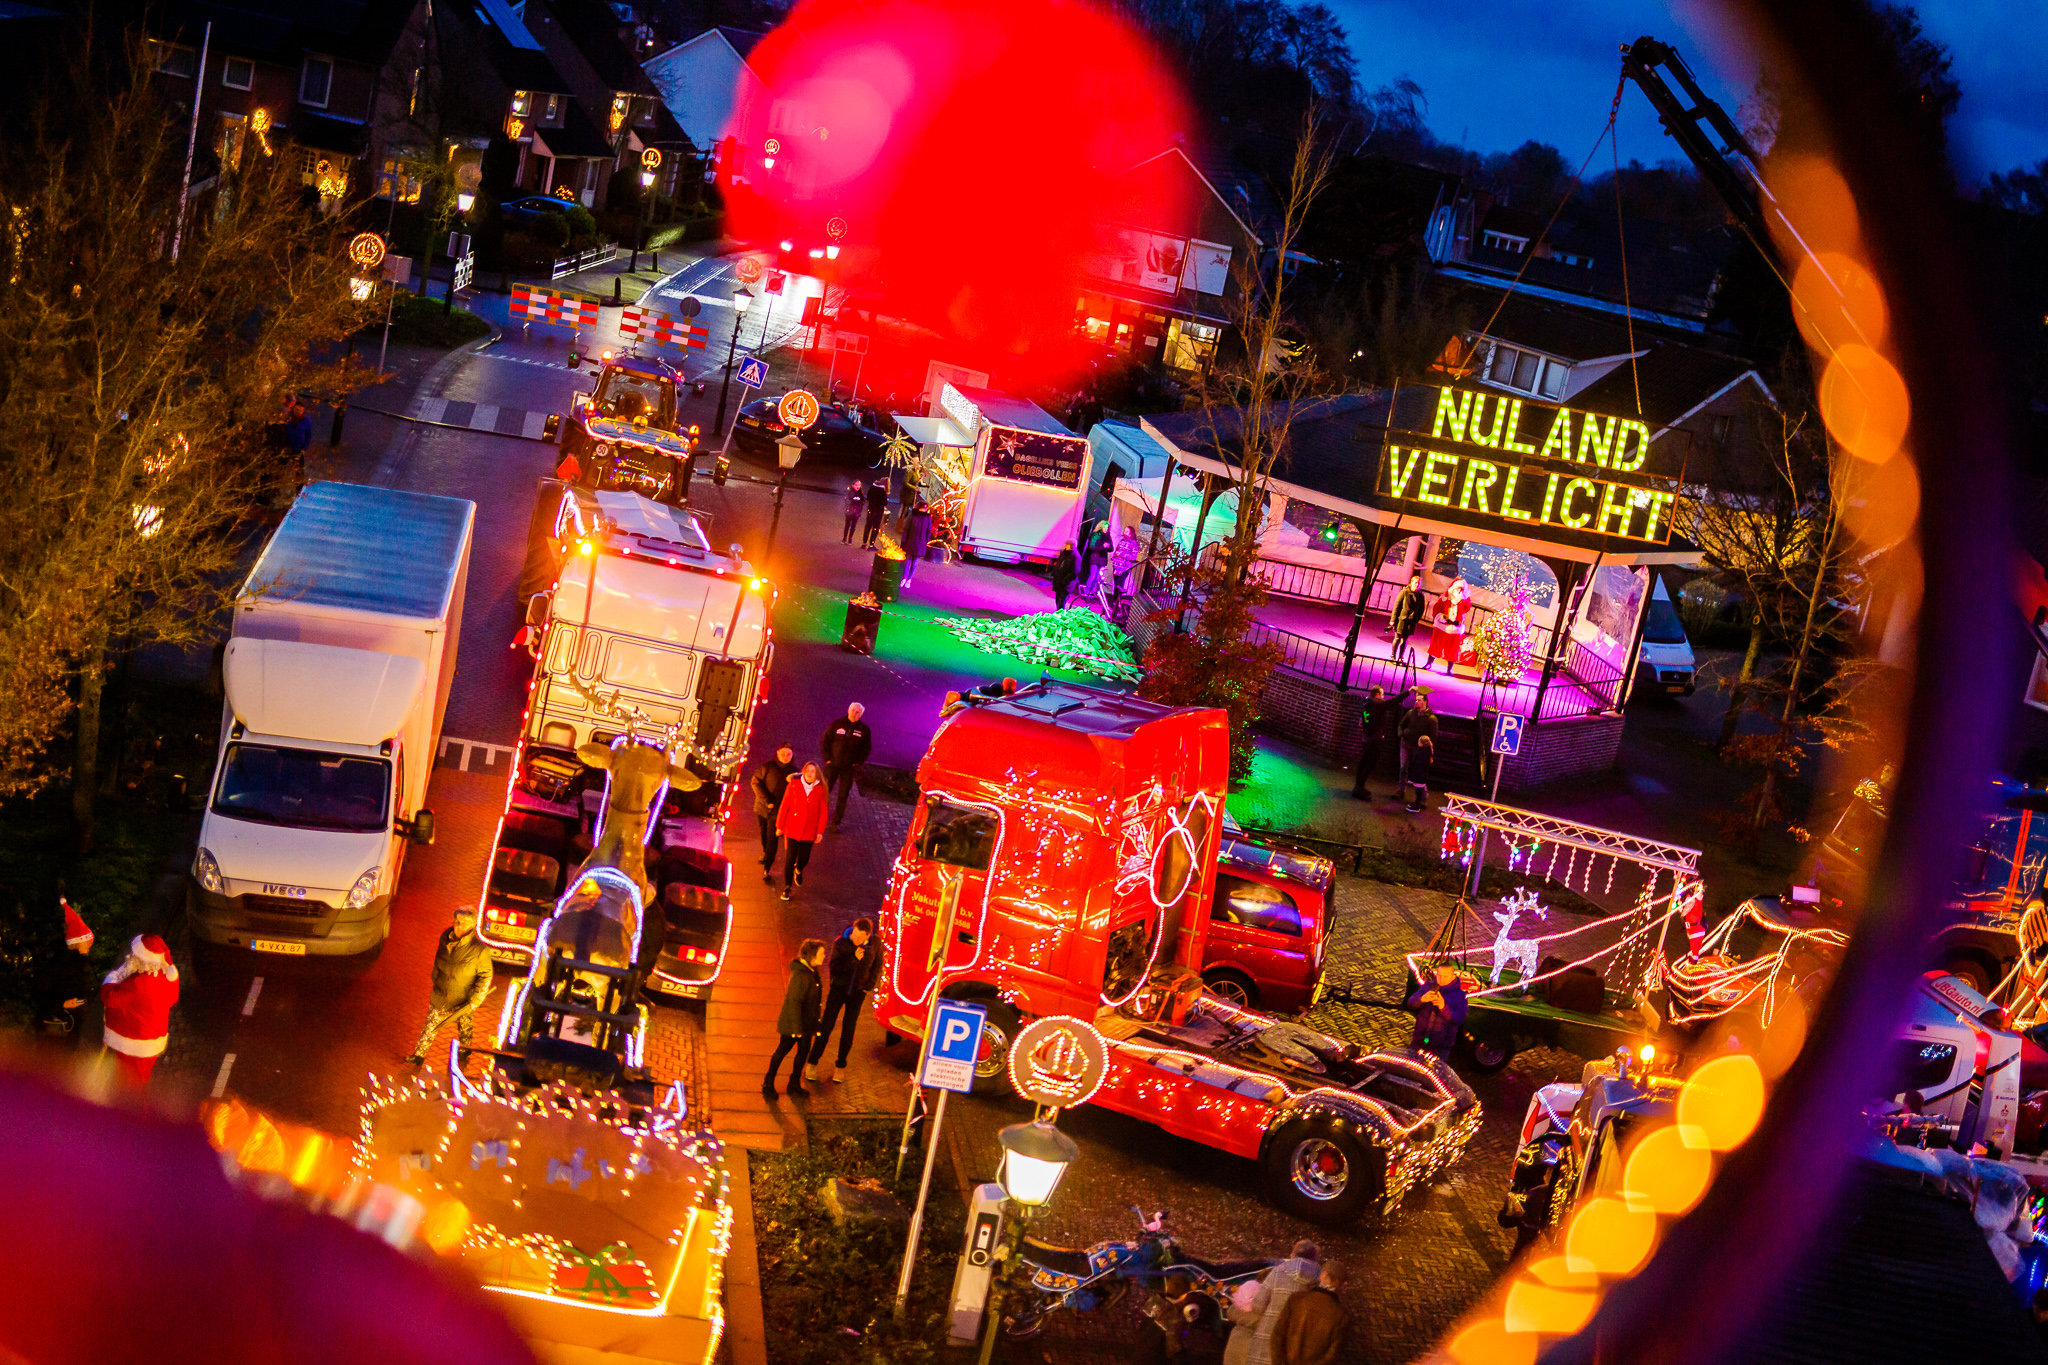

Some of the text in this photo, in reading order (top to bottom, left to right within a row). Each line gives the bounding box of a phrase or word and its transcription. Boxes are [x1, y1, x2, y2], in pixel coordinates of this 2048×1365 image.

[1432, 386, 1649, 472] NULAND
[1012, 463, 1076, 483] OLIEBOLLEN
[1390, 446, 1674, 541] VERLICHT
[1501, 716, 1517, 736] P
[263, 884, 306, 897] IVECO
[259, 942, 301, 953] 4-VXX-87
[490, 949, 526, 962] DAF
[661, 980, 699, 995] DAF
[1934, 980, 1985, 1016] JBGauto.nl
[941, 1018, 971, 1051] P
